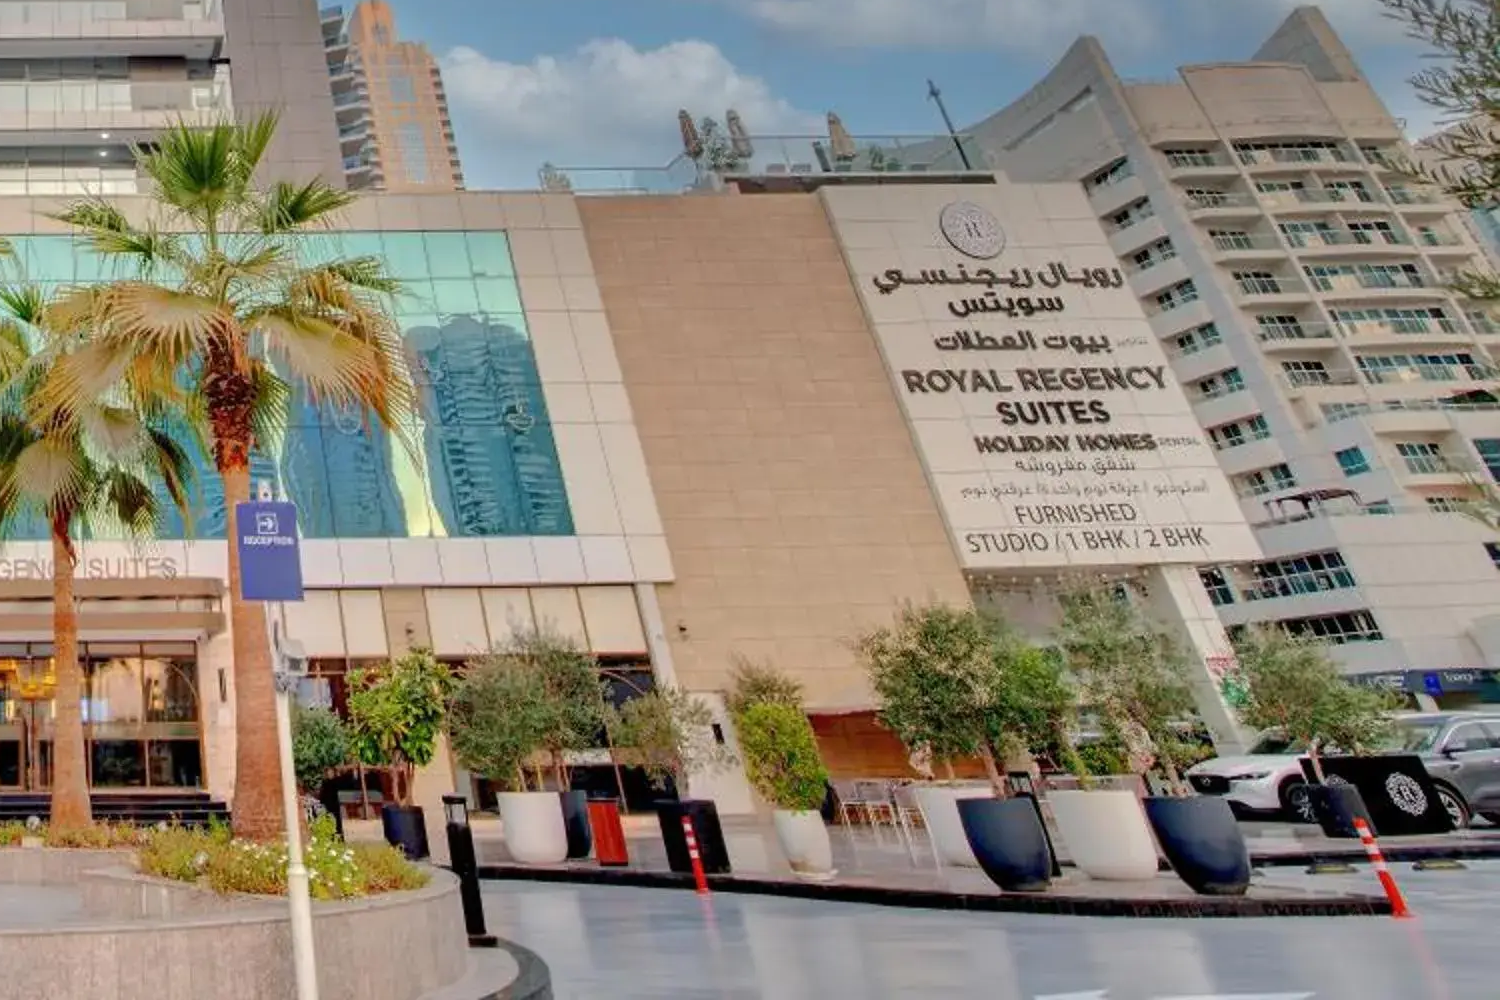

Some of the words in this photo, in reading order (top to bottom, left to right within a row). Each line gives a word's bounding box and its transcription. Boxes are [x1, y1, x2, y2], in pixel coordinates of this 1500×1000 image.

[872, 263, 1035, 294] ريجنسي
[1038, 261, 1124, 289] رويال
[948, 291, 1065, 318] سويتس
[934, 330, 1037, 351] العطلات
[1043, 335, 1112, 353] بيوت
[902, 368, 1012, 393] ROYAL
[1016, 365, 1166, 391] REGENCY
[996, 400, 1111, 426] SUITES
[973, 435, 1070, 454] HOLIDAY
[1075, 433, 1157, 452] HOMES
[1015, 503, 1136, 525] FURNISHED
[966, 532, 1049, 553] STUDIO
[1083, 530, 1130, 549] BHK
[1144, 528, 1161, 548] 2
[1164, 527, 1210, 547] BHK
[88, 557, 178, 580] SUITES
